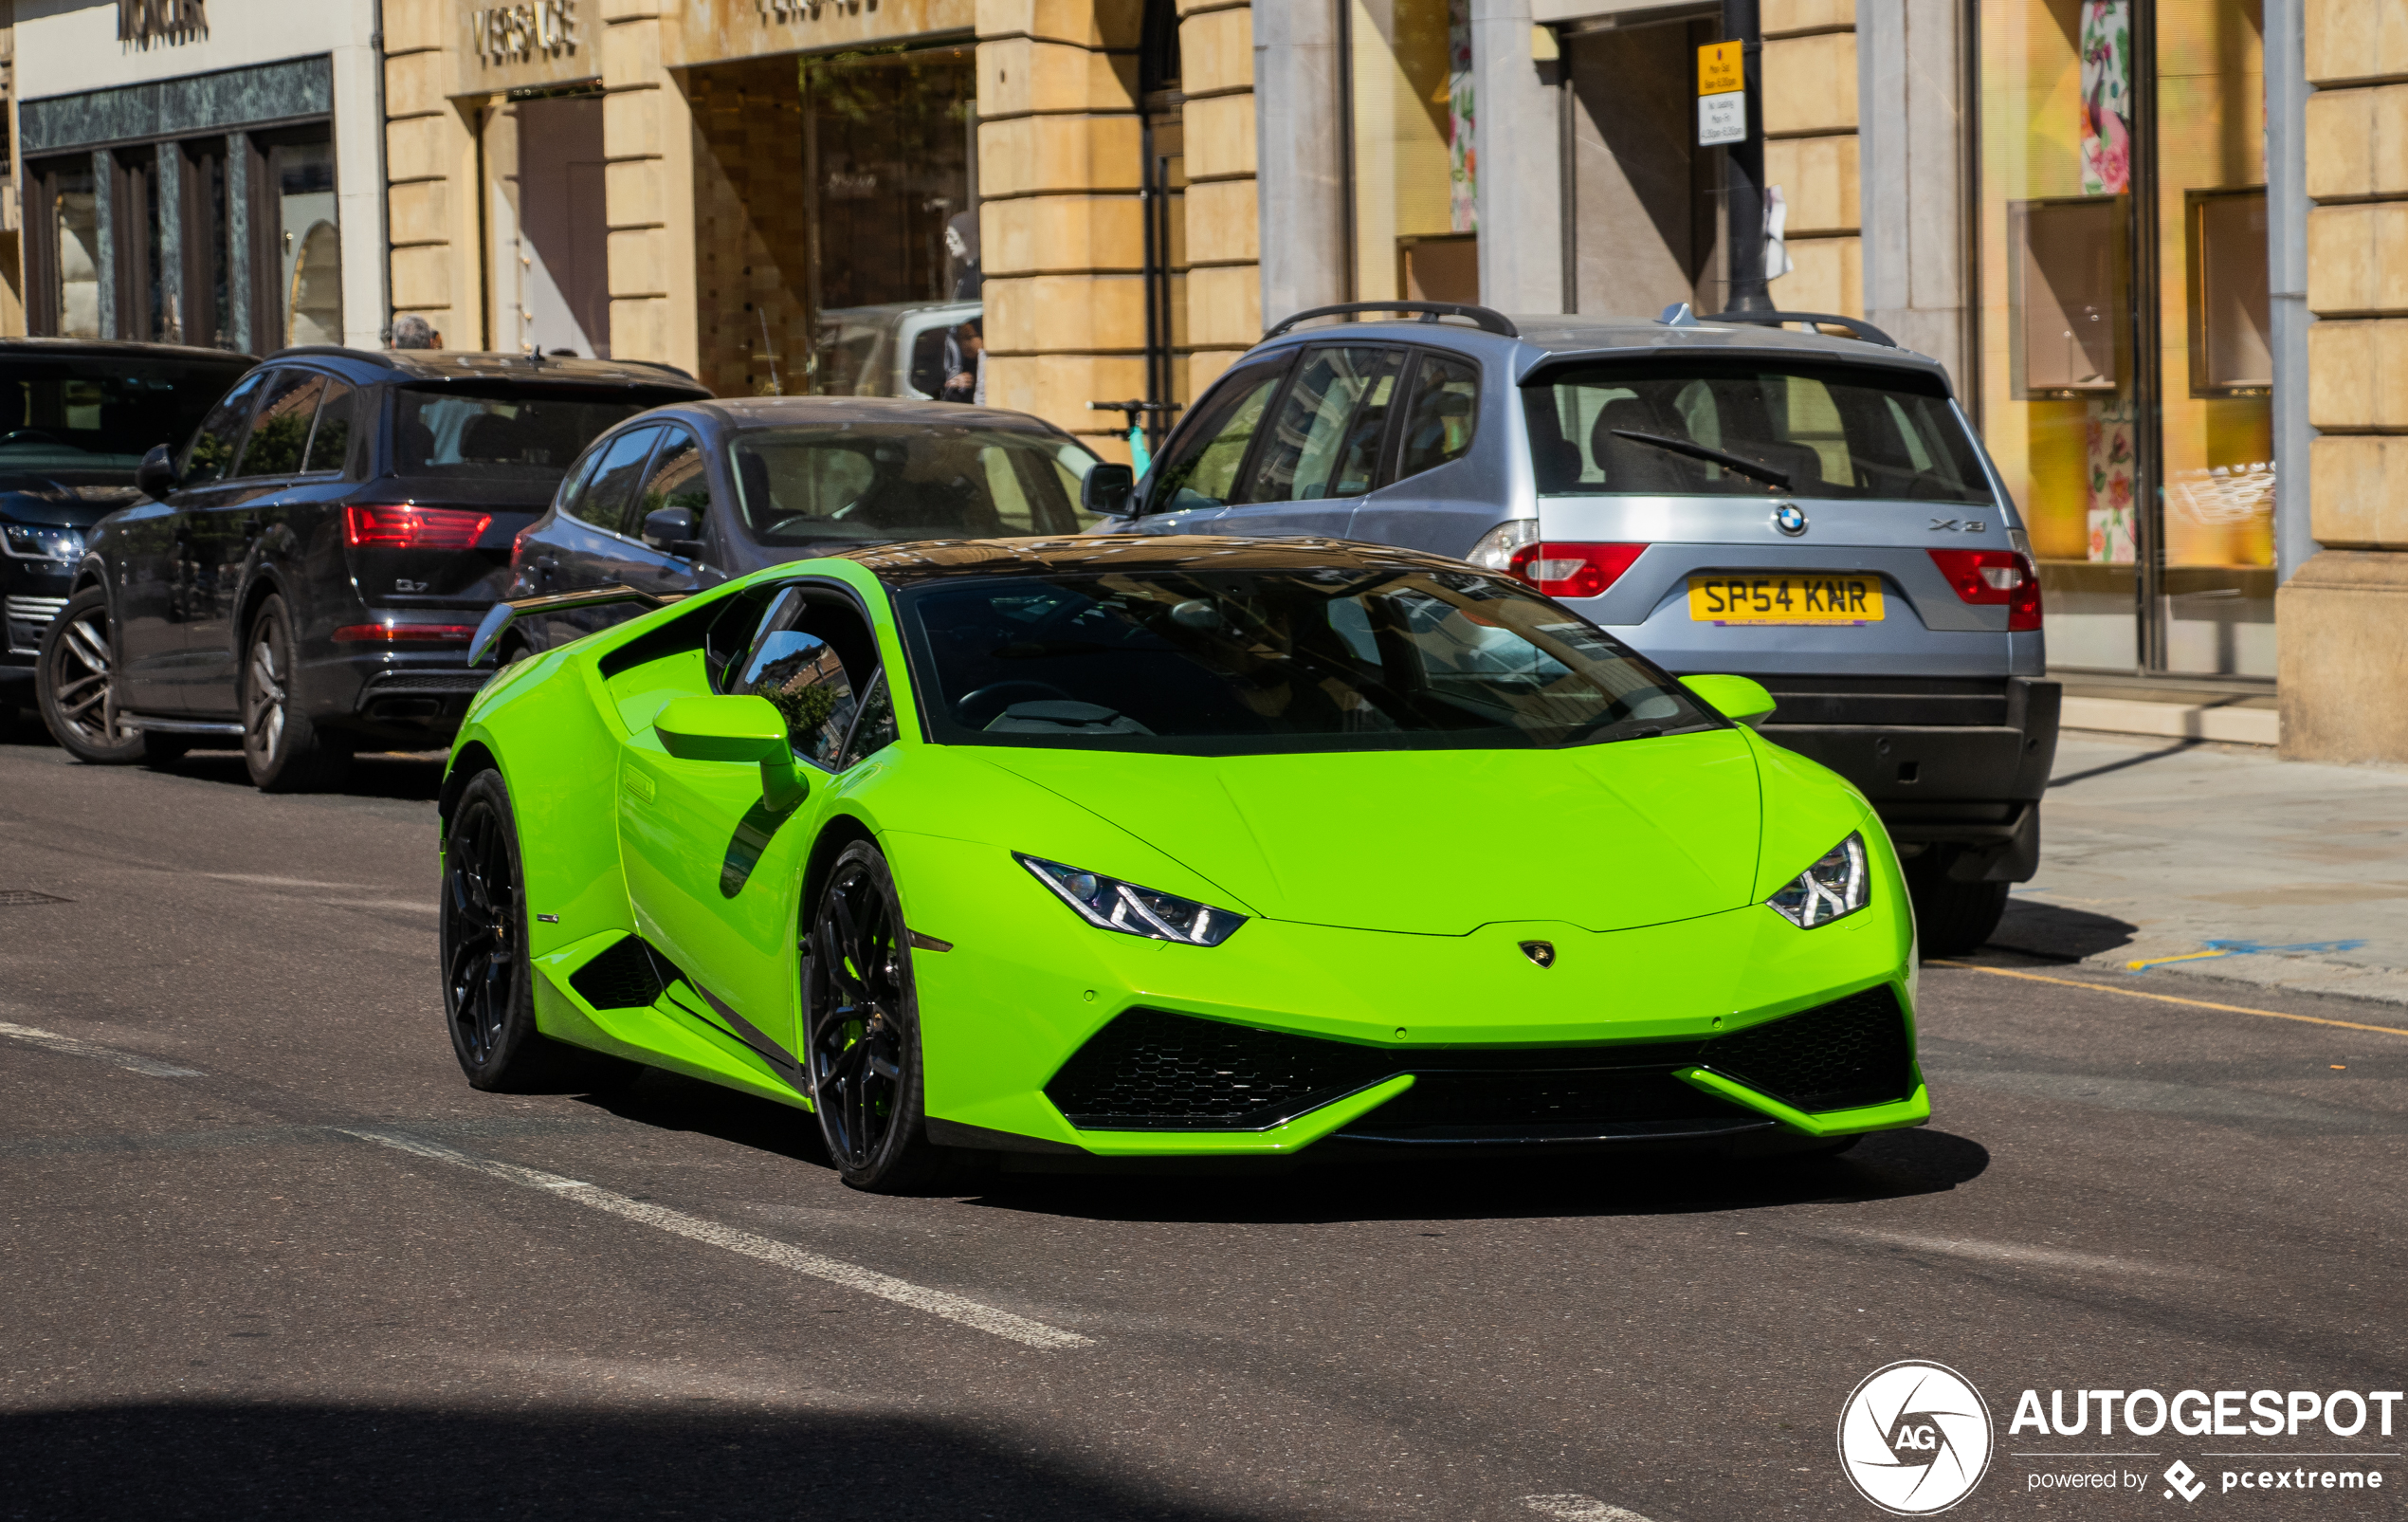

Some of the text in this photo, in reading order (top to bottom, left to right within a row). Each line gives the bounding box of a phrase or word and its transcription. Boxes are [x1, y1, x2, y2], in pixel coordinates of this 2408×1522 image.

[471, 0, 579, 59] VERSACE
[1929, 518, 1987, 533] X3
[395, 578, 429, 593] Q7
[1706, 579, 1868, 613] SP54 KNR
